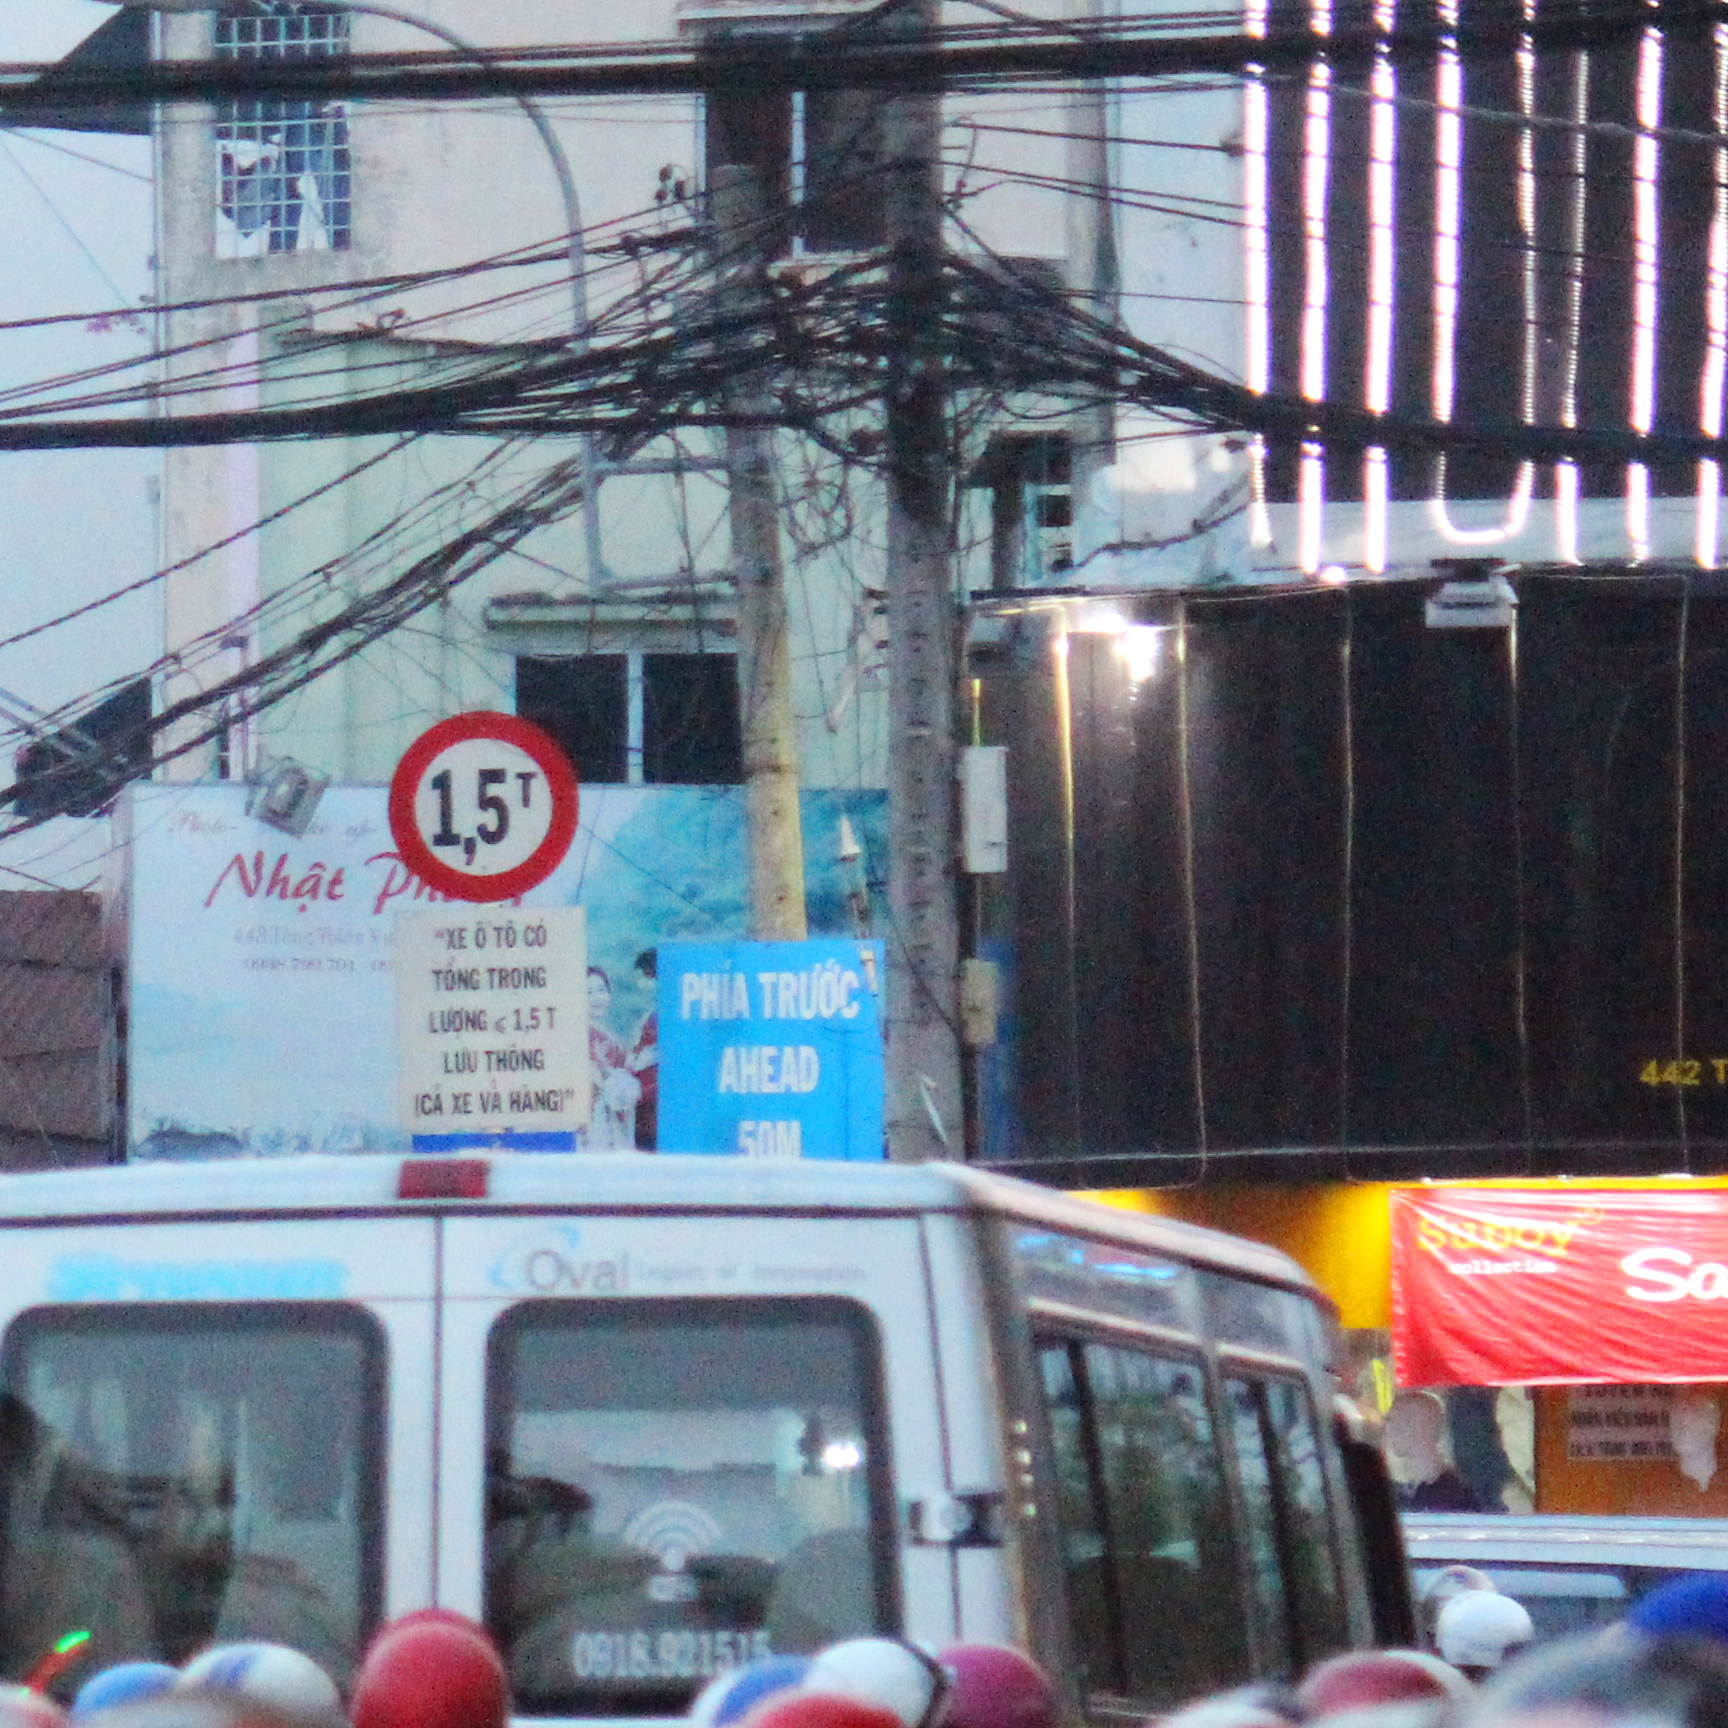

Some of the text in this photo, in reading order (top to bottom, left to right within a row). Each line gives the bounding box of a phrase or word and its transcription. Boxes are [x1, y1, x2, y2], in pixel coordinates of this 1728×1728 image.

[204, 850, 345, 913] Nhật
[475, 920, 487, 949] Ô
[493, 920, 517, 948] TÔ
[523, 918, 547, 947] CÓ
[432, 956, 480, 991] TỔNG
[681, 957, 861, 1020] PHÍA TRƯỚC
[429, 1007, 487, 1038] LƯỢNG
[546, 1007, 556, 1029] T
[484, 1044, 545, 1073] THÔNG
[718, 1045, 820, 1093] AHEAD
[1640, 1059, 1701, 1087] 442
[451, 1092, 473, 1115] XE
[739, 1120, 802, 1158] 50M
[524, 1251, 629, 1290] Oval
[1449, 1259, 1557, 1275] collection
